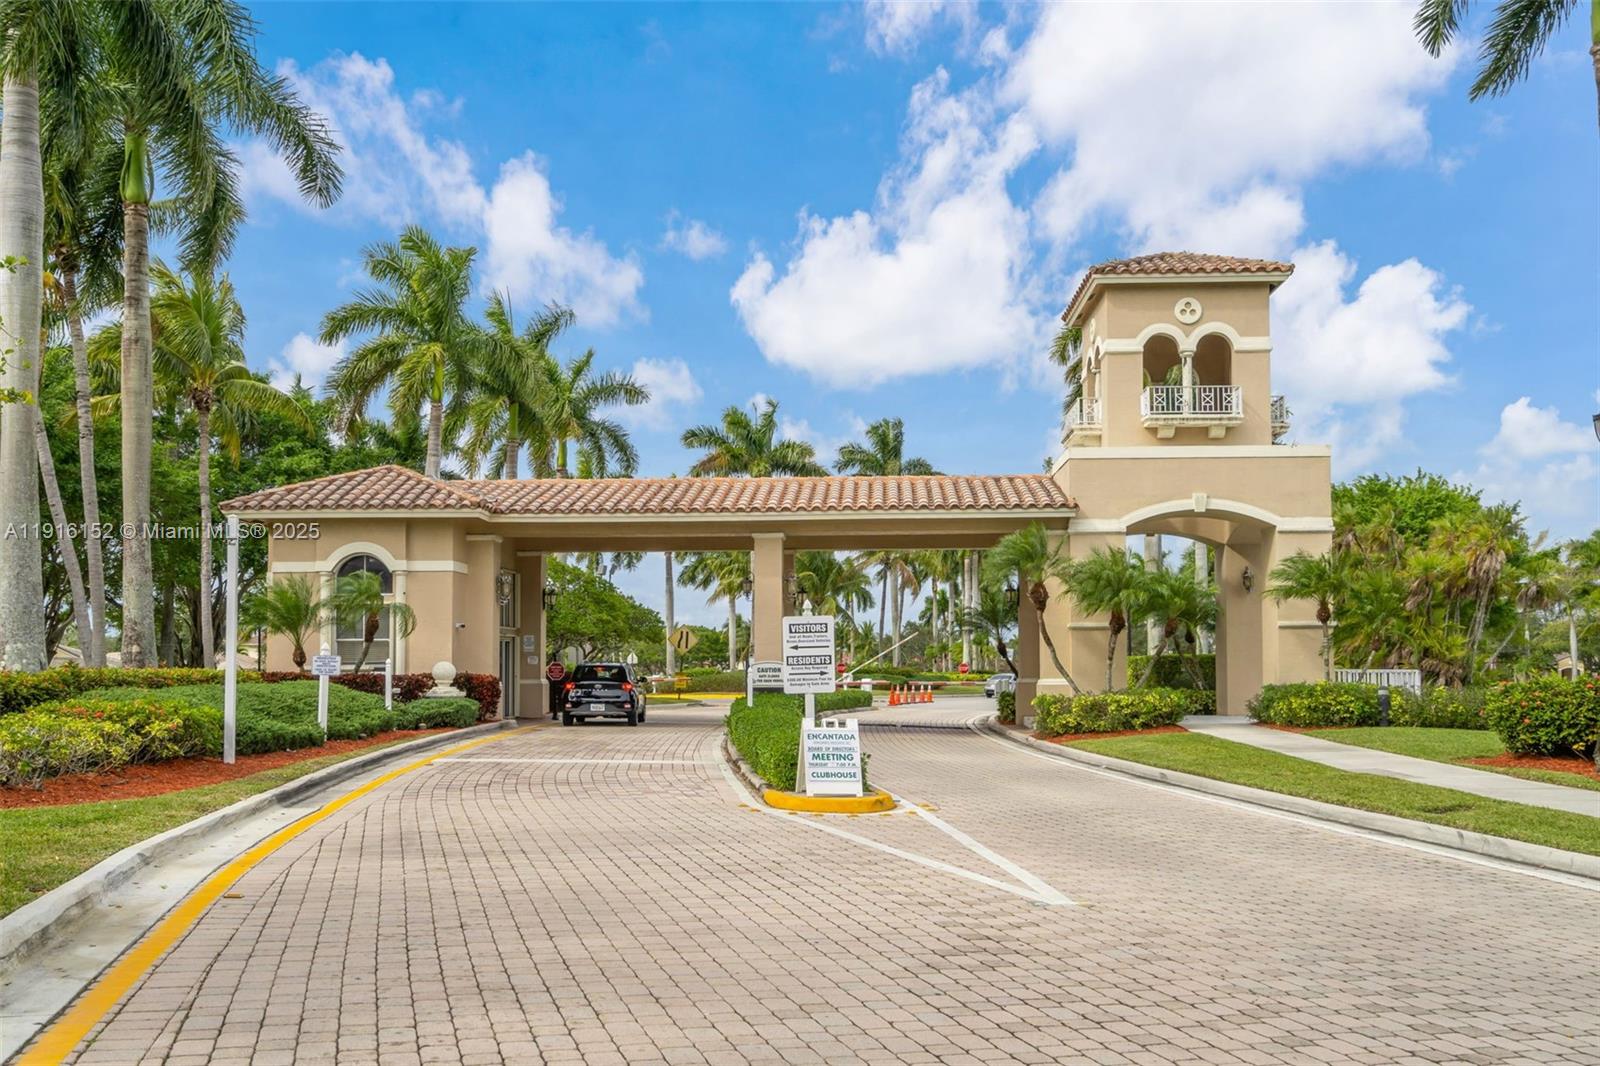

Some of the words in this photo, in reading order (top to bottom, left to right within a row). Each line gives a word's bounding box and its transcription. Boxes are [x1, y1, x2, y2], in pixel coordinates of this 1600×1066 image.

[790, 624, 827, 633] VISITORS
[787, 656, 831, 665] RESIDENTS
[807, 733, 856, 741] ENCANTADA
[811, 753, 854, 761] MEETING
[811, 771, 857, 779] CLUBHOUSE
